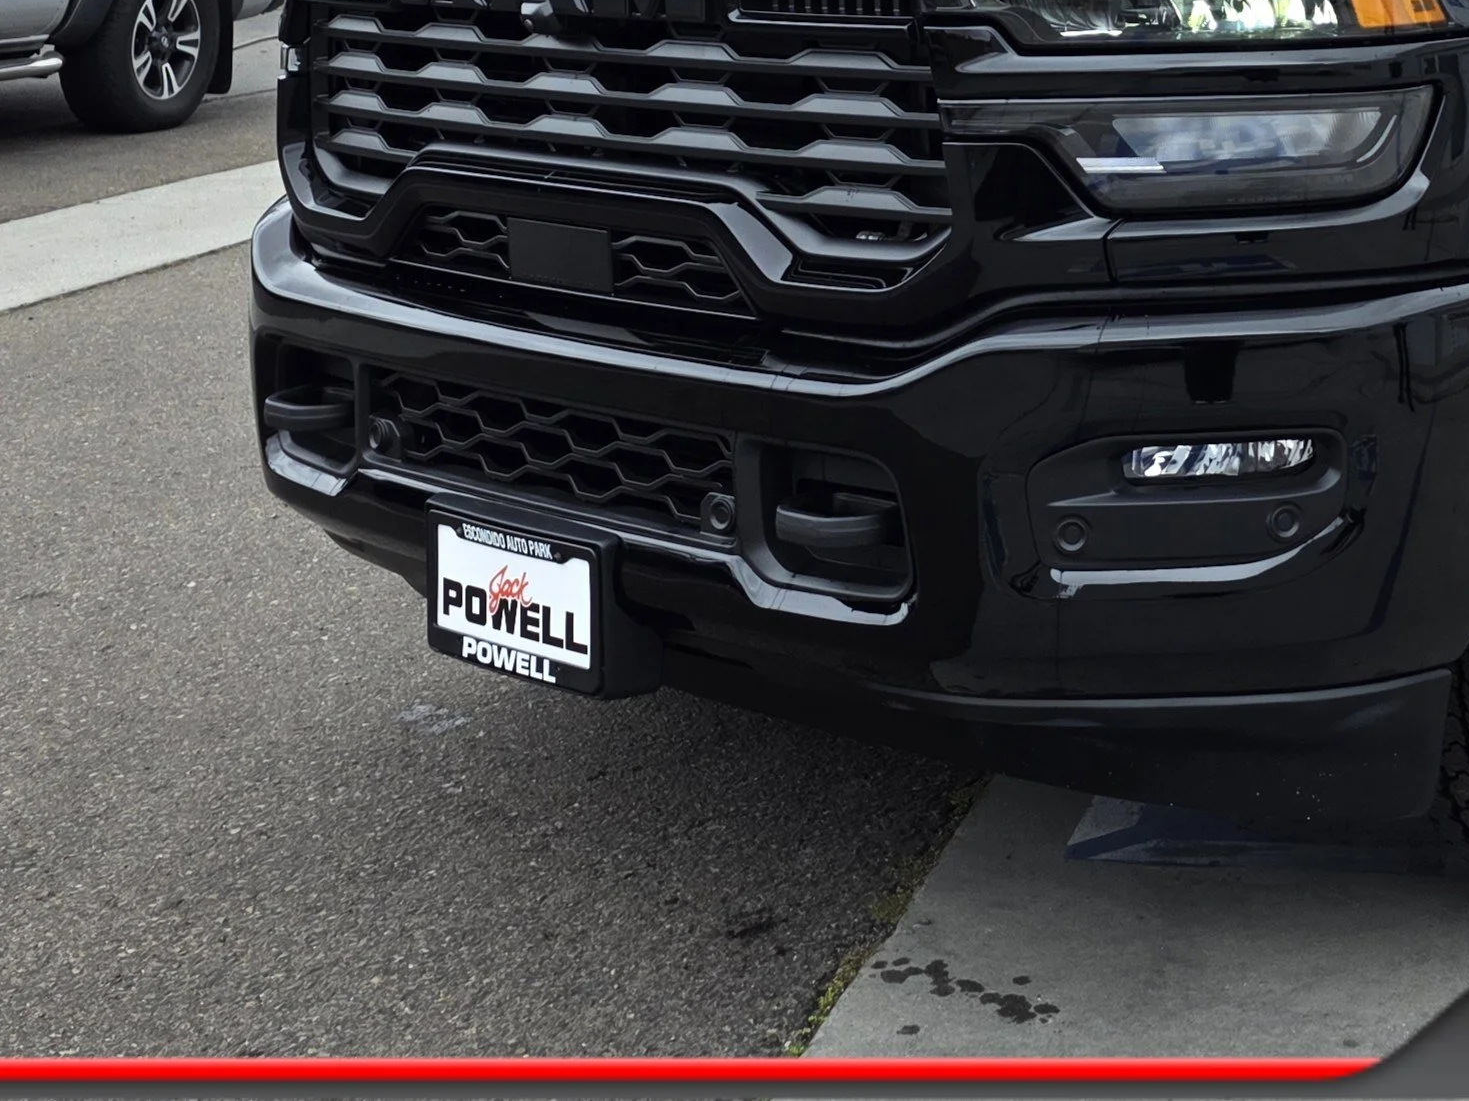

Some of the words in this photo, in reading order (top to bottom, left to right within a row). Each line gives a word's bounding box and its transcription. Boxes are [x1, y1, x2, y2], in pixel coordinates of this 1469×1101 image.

[462, 523, 506, 552] ESCONDIDO
[506, 535, 528, 554] AUTO
[528, 539, 553, 560] PARK
[489, 565, 533, 615] Jack
[443, 577, 588, 655] POWELL
[462, 636, 556, 683] POWELL
